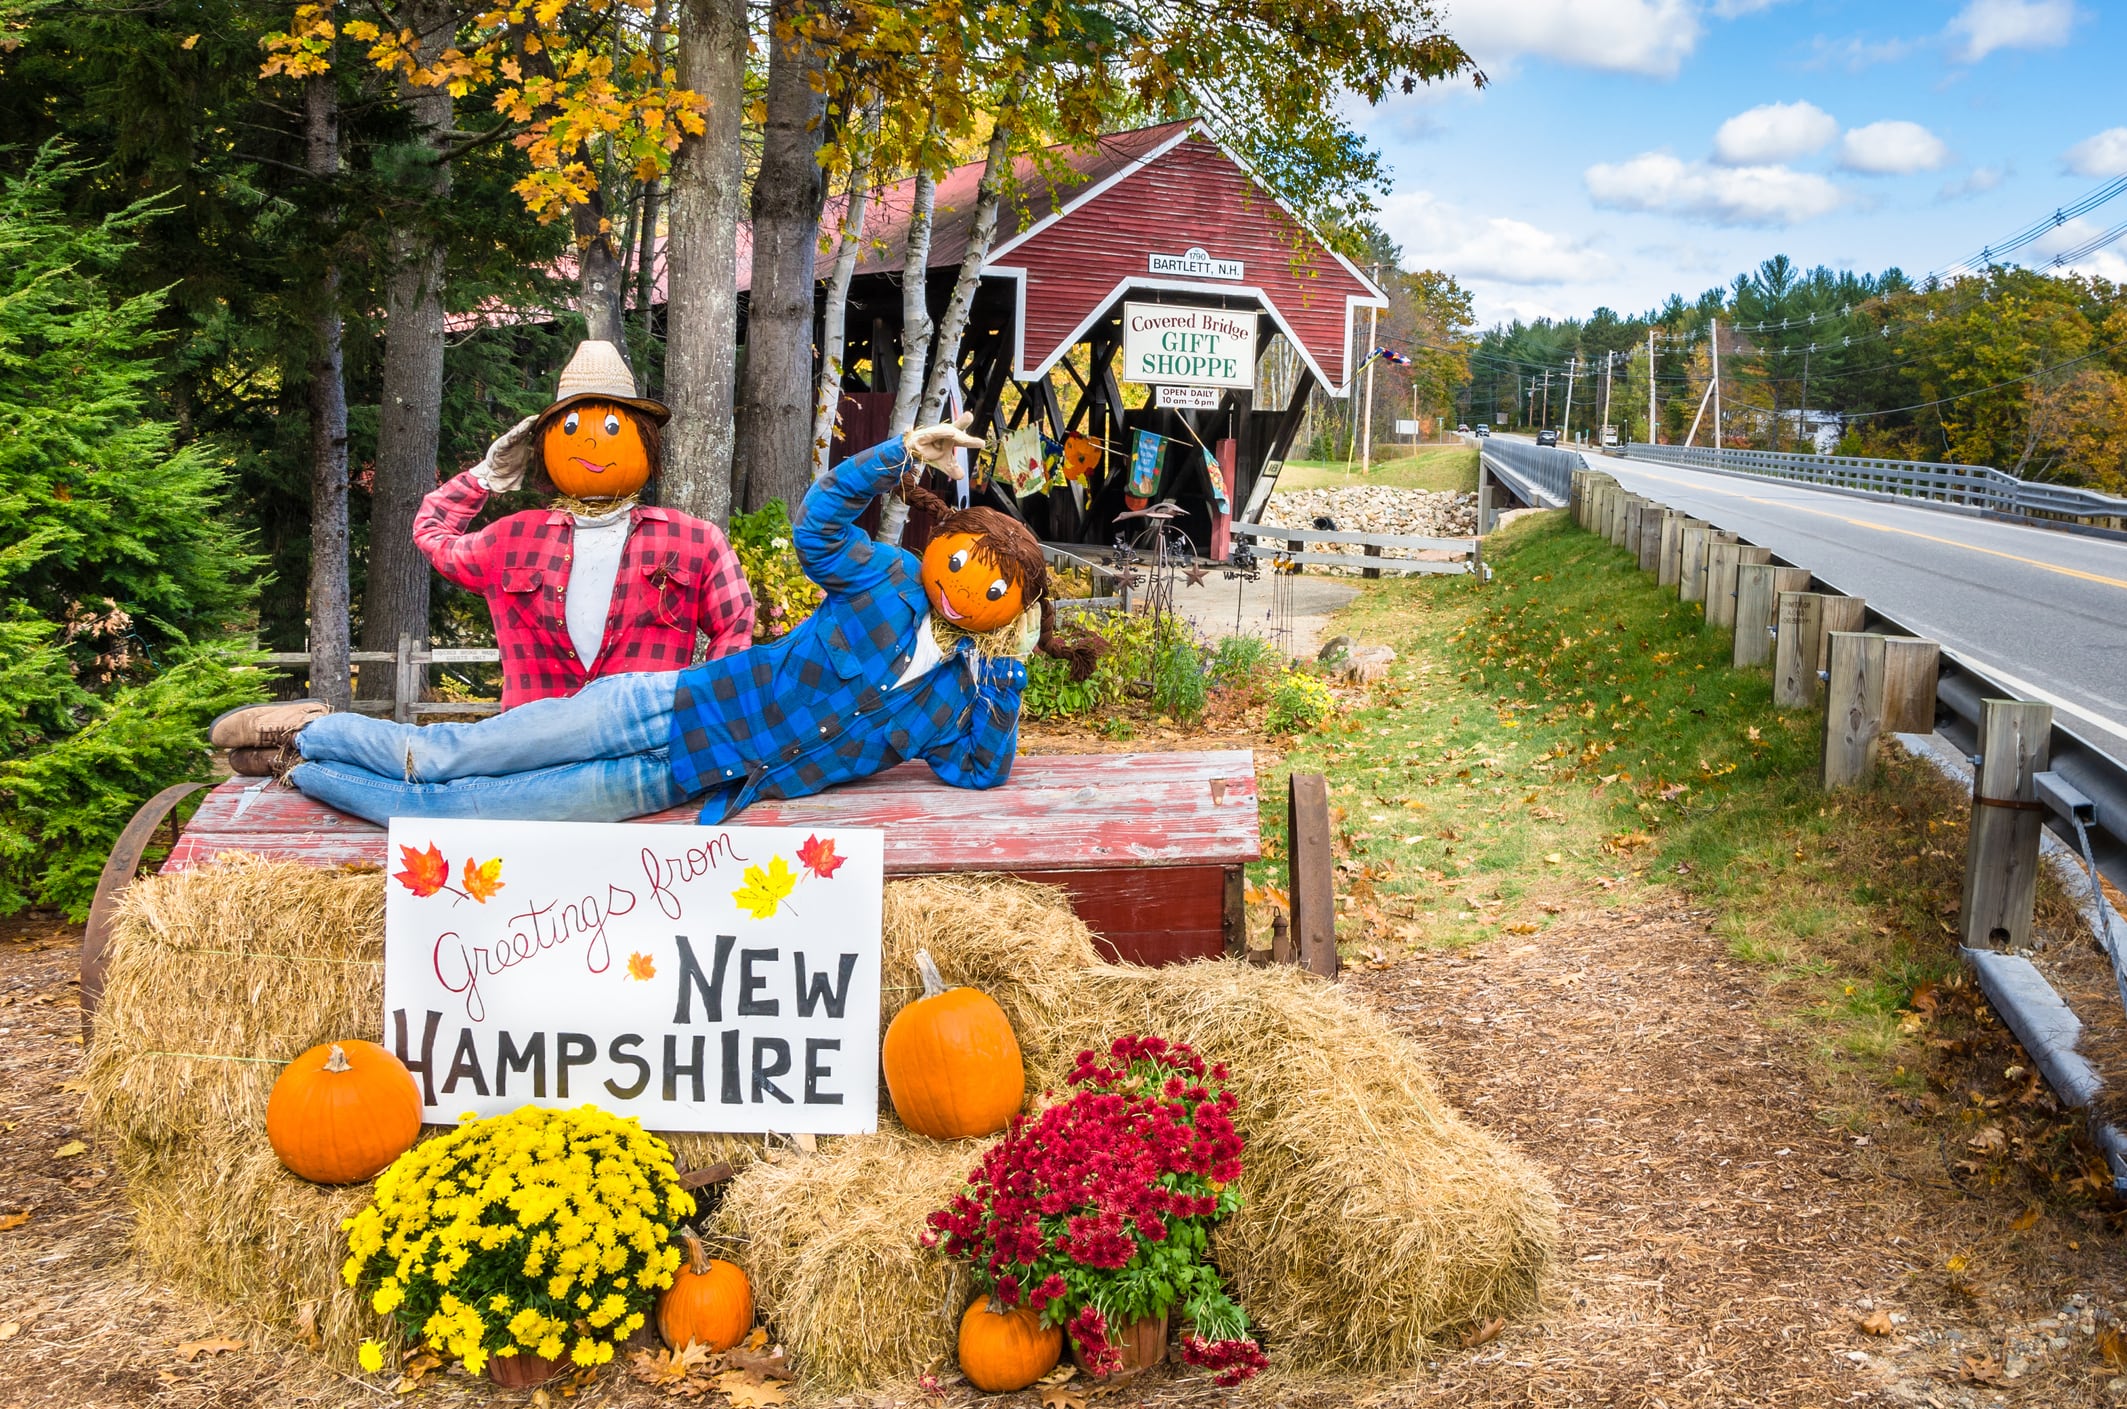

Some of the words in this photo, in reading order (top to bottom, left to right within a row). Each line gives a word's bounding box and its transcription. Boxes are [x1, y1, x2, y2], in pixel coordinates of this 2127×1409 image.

[1153, 258, 1214, 275] BARTLETT,
[1218, 263, 1240, 276] N.H.
[1190, 252, 1206, 261] 1790
[1131, 313, 1196, 332] Covered
[1202, 314, 1249, 340] Bridge
[1161, 331, 1220, 354] GIFT
[1142, 353, 1237, 378] SHOPPE
[1162, 388, 1187, 396] OPEN
[1190, 389, 1214, 398] DAILY
[433, 883, 636, 1022] Greetings
[641, 832, 749, 920] from
[673, 934, 859, 1024] NEW
[392, 1007, 844, 1107] HAMPSHIRE
